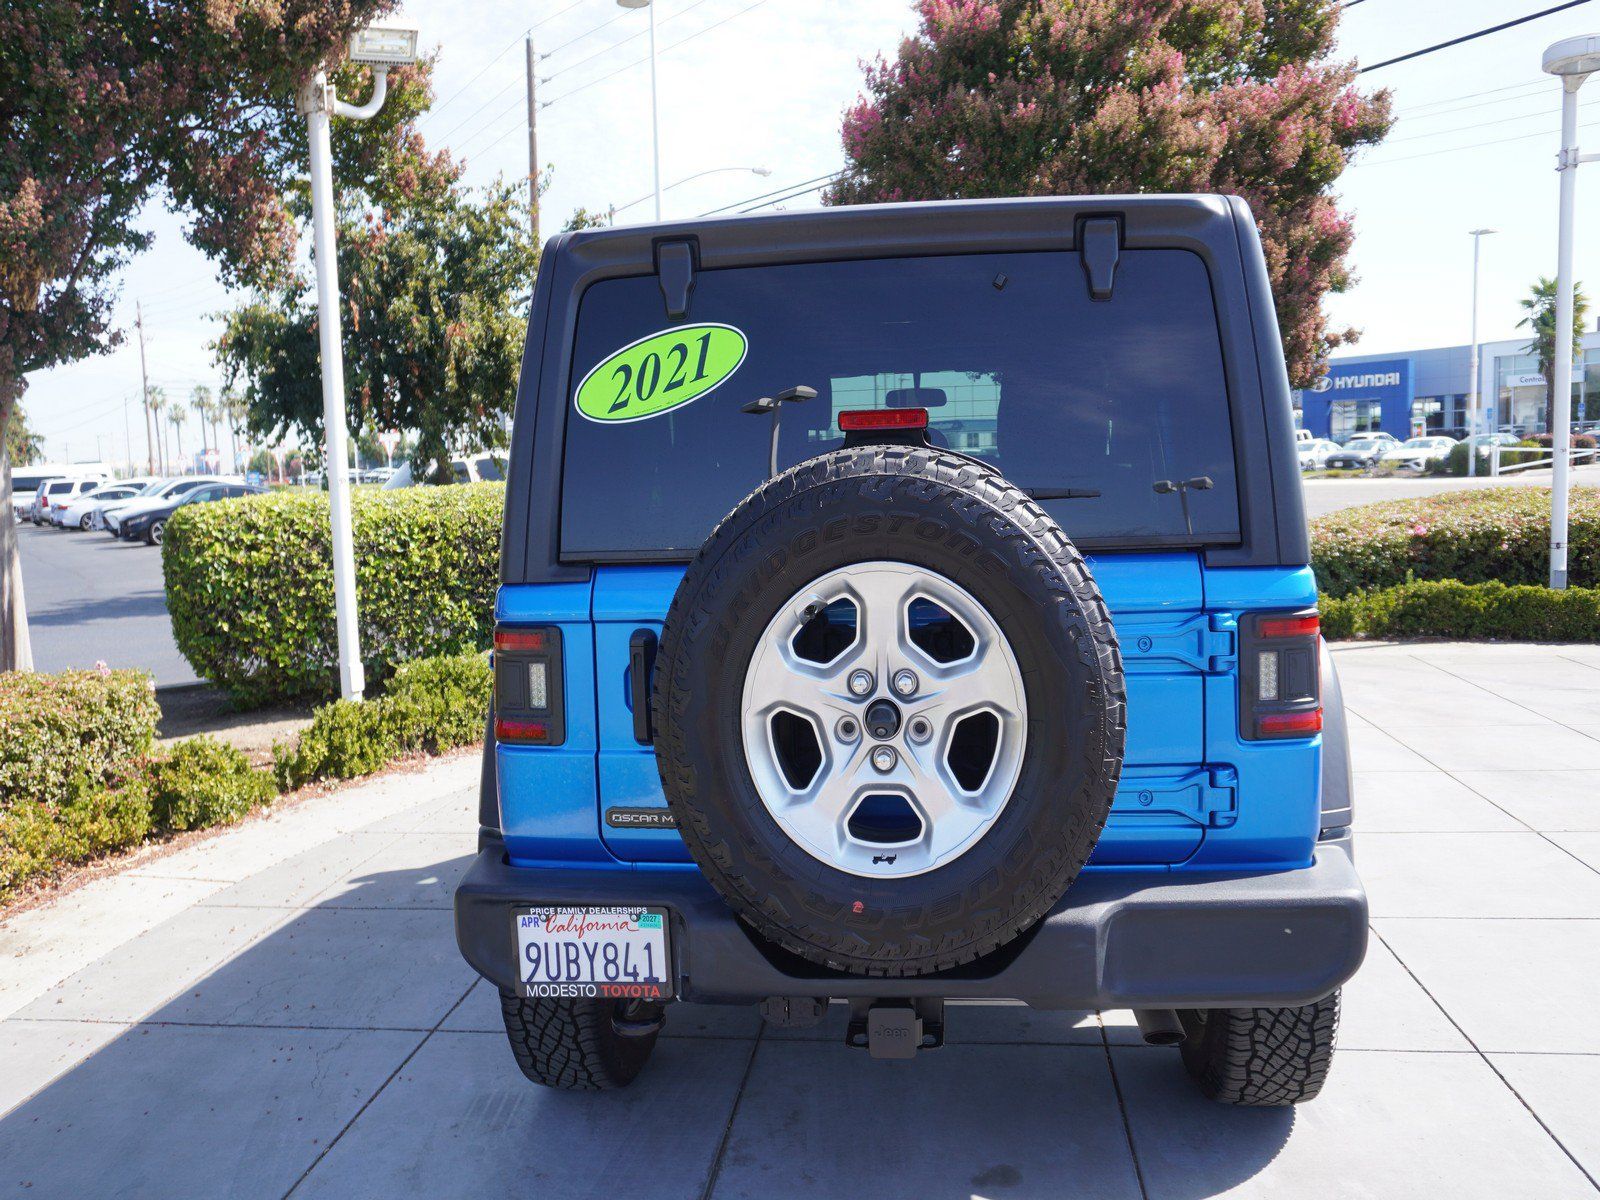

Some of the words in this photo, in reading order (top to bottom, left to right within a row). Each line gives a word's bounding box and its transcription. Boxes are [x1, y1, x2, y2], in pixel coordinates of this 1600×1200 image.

[607, 331, 712, 414] 2021
[1335, 372, 1400, 389] HYUNDAI
[612, 814, 659, 823] OSCAR
[530, 907, 555, 915] PRICE
[557, 907, 587, 915] FAMILY
[589, 907, 648, 915] DEALERSHIPS
[521, 916, 540, 928] APR
[545, 913, 639, 939] California
[525, 942, 660, 983] 9UBY841
[526, 984, 597, 997] MODESTO
[601, 985, 661, 997] TOYOTA
